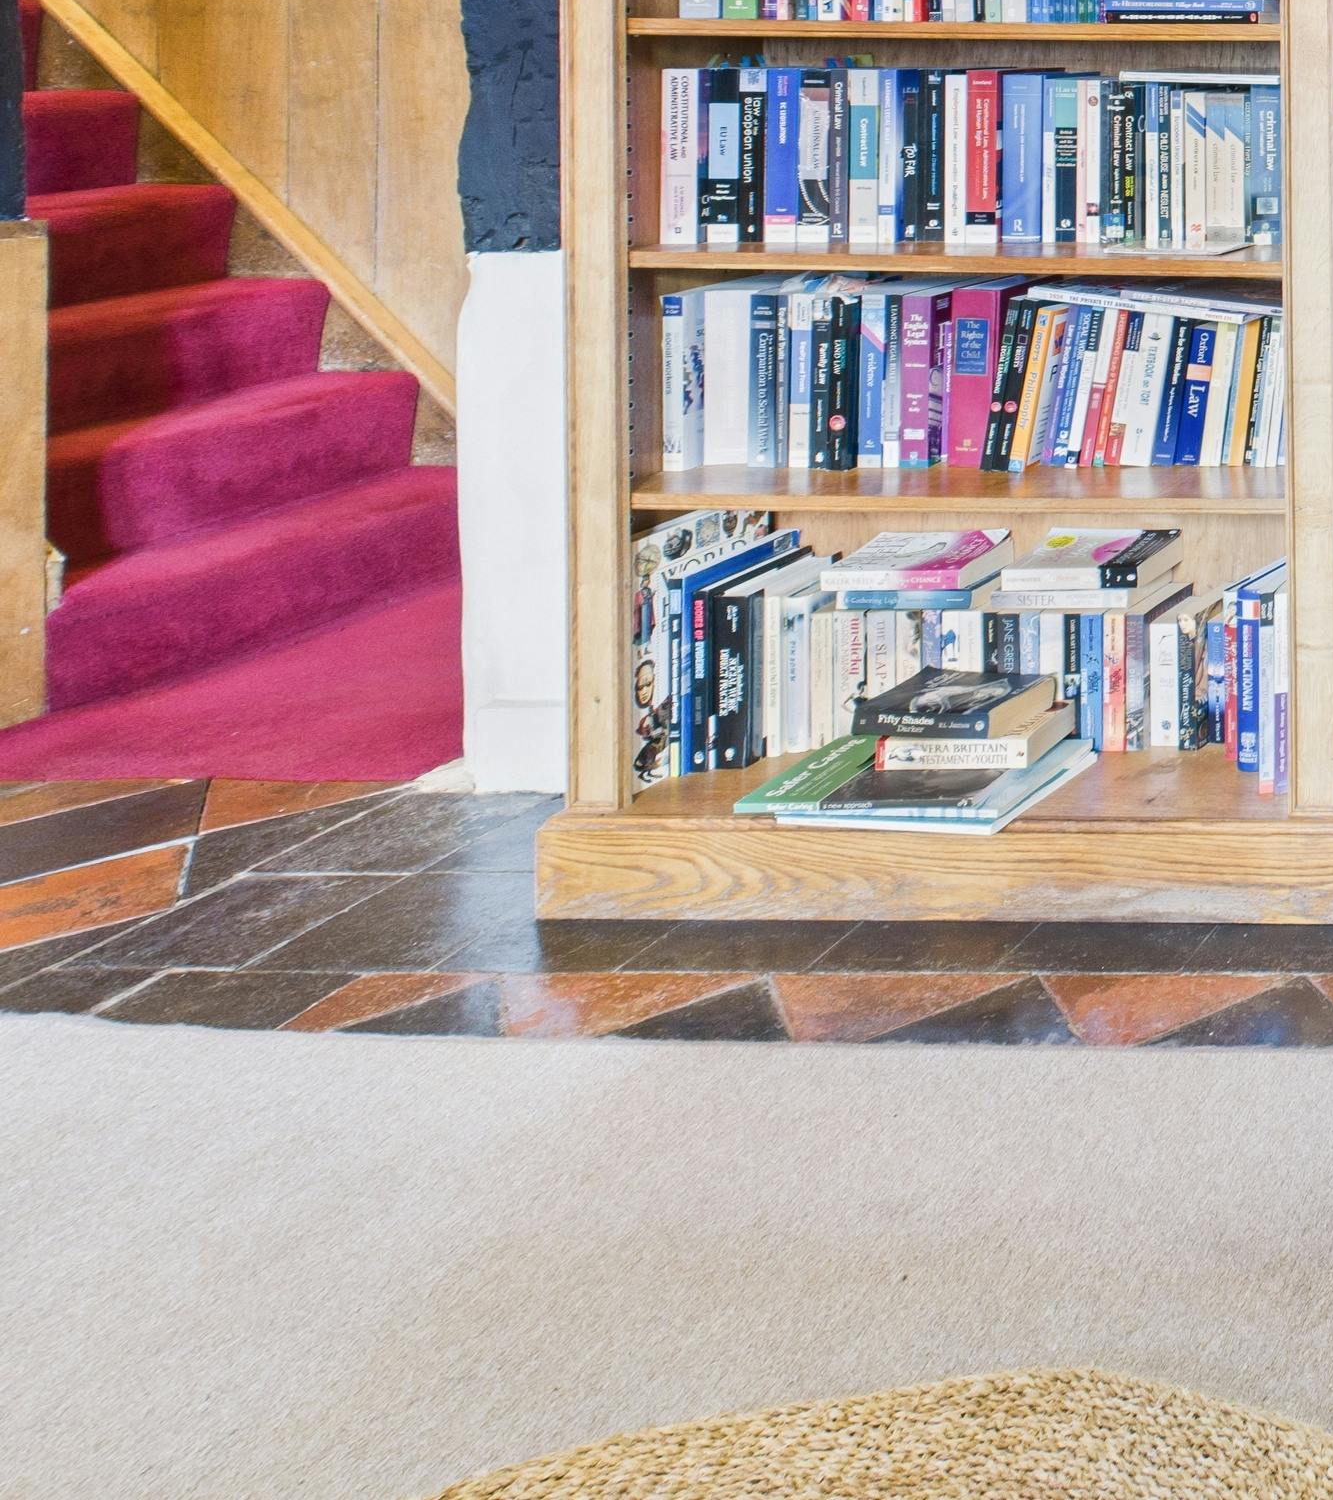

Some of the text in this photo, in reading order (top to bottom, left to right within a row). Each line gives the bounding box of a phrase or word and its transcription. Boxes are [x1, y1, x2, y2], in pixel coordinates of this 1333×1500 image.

[752, 97, 763, 116] law
[719, 126, 728, 156] EU Law
[741, 97, 753, 183] european union
[1159, 132, 1169, 150] CHILD
[1265, 110, 1276, 170] criminal law
[904, 143, 917, 177] TOO FAR
[1159, 151, 1169, 173] ABUSE
[1160, 190, 1169, 218] NEGLECT
[866, 352, 876, 387] evidence
[1144, 345, 1159, 380] TEXTBOOK
[1187, 332, 1209, 417] Oxford Law
[1017, 372, 1039, 430] Philosophy
[1139, 390, 1152, 405] TORT
[847, 617, 863, 676] unsticky
[875, 620, 887, 679] THE SLAP
[1241, 658, 1254, 711] DICTIONARY
